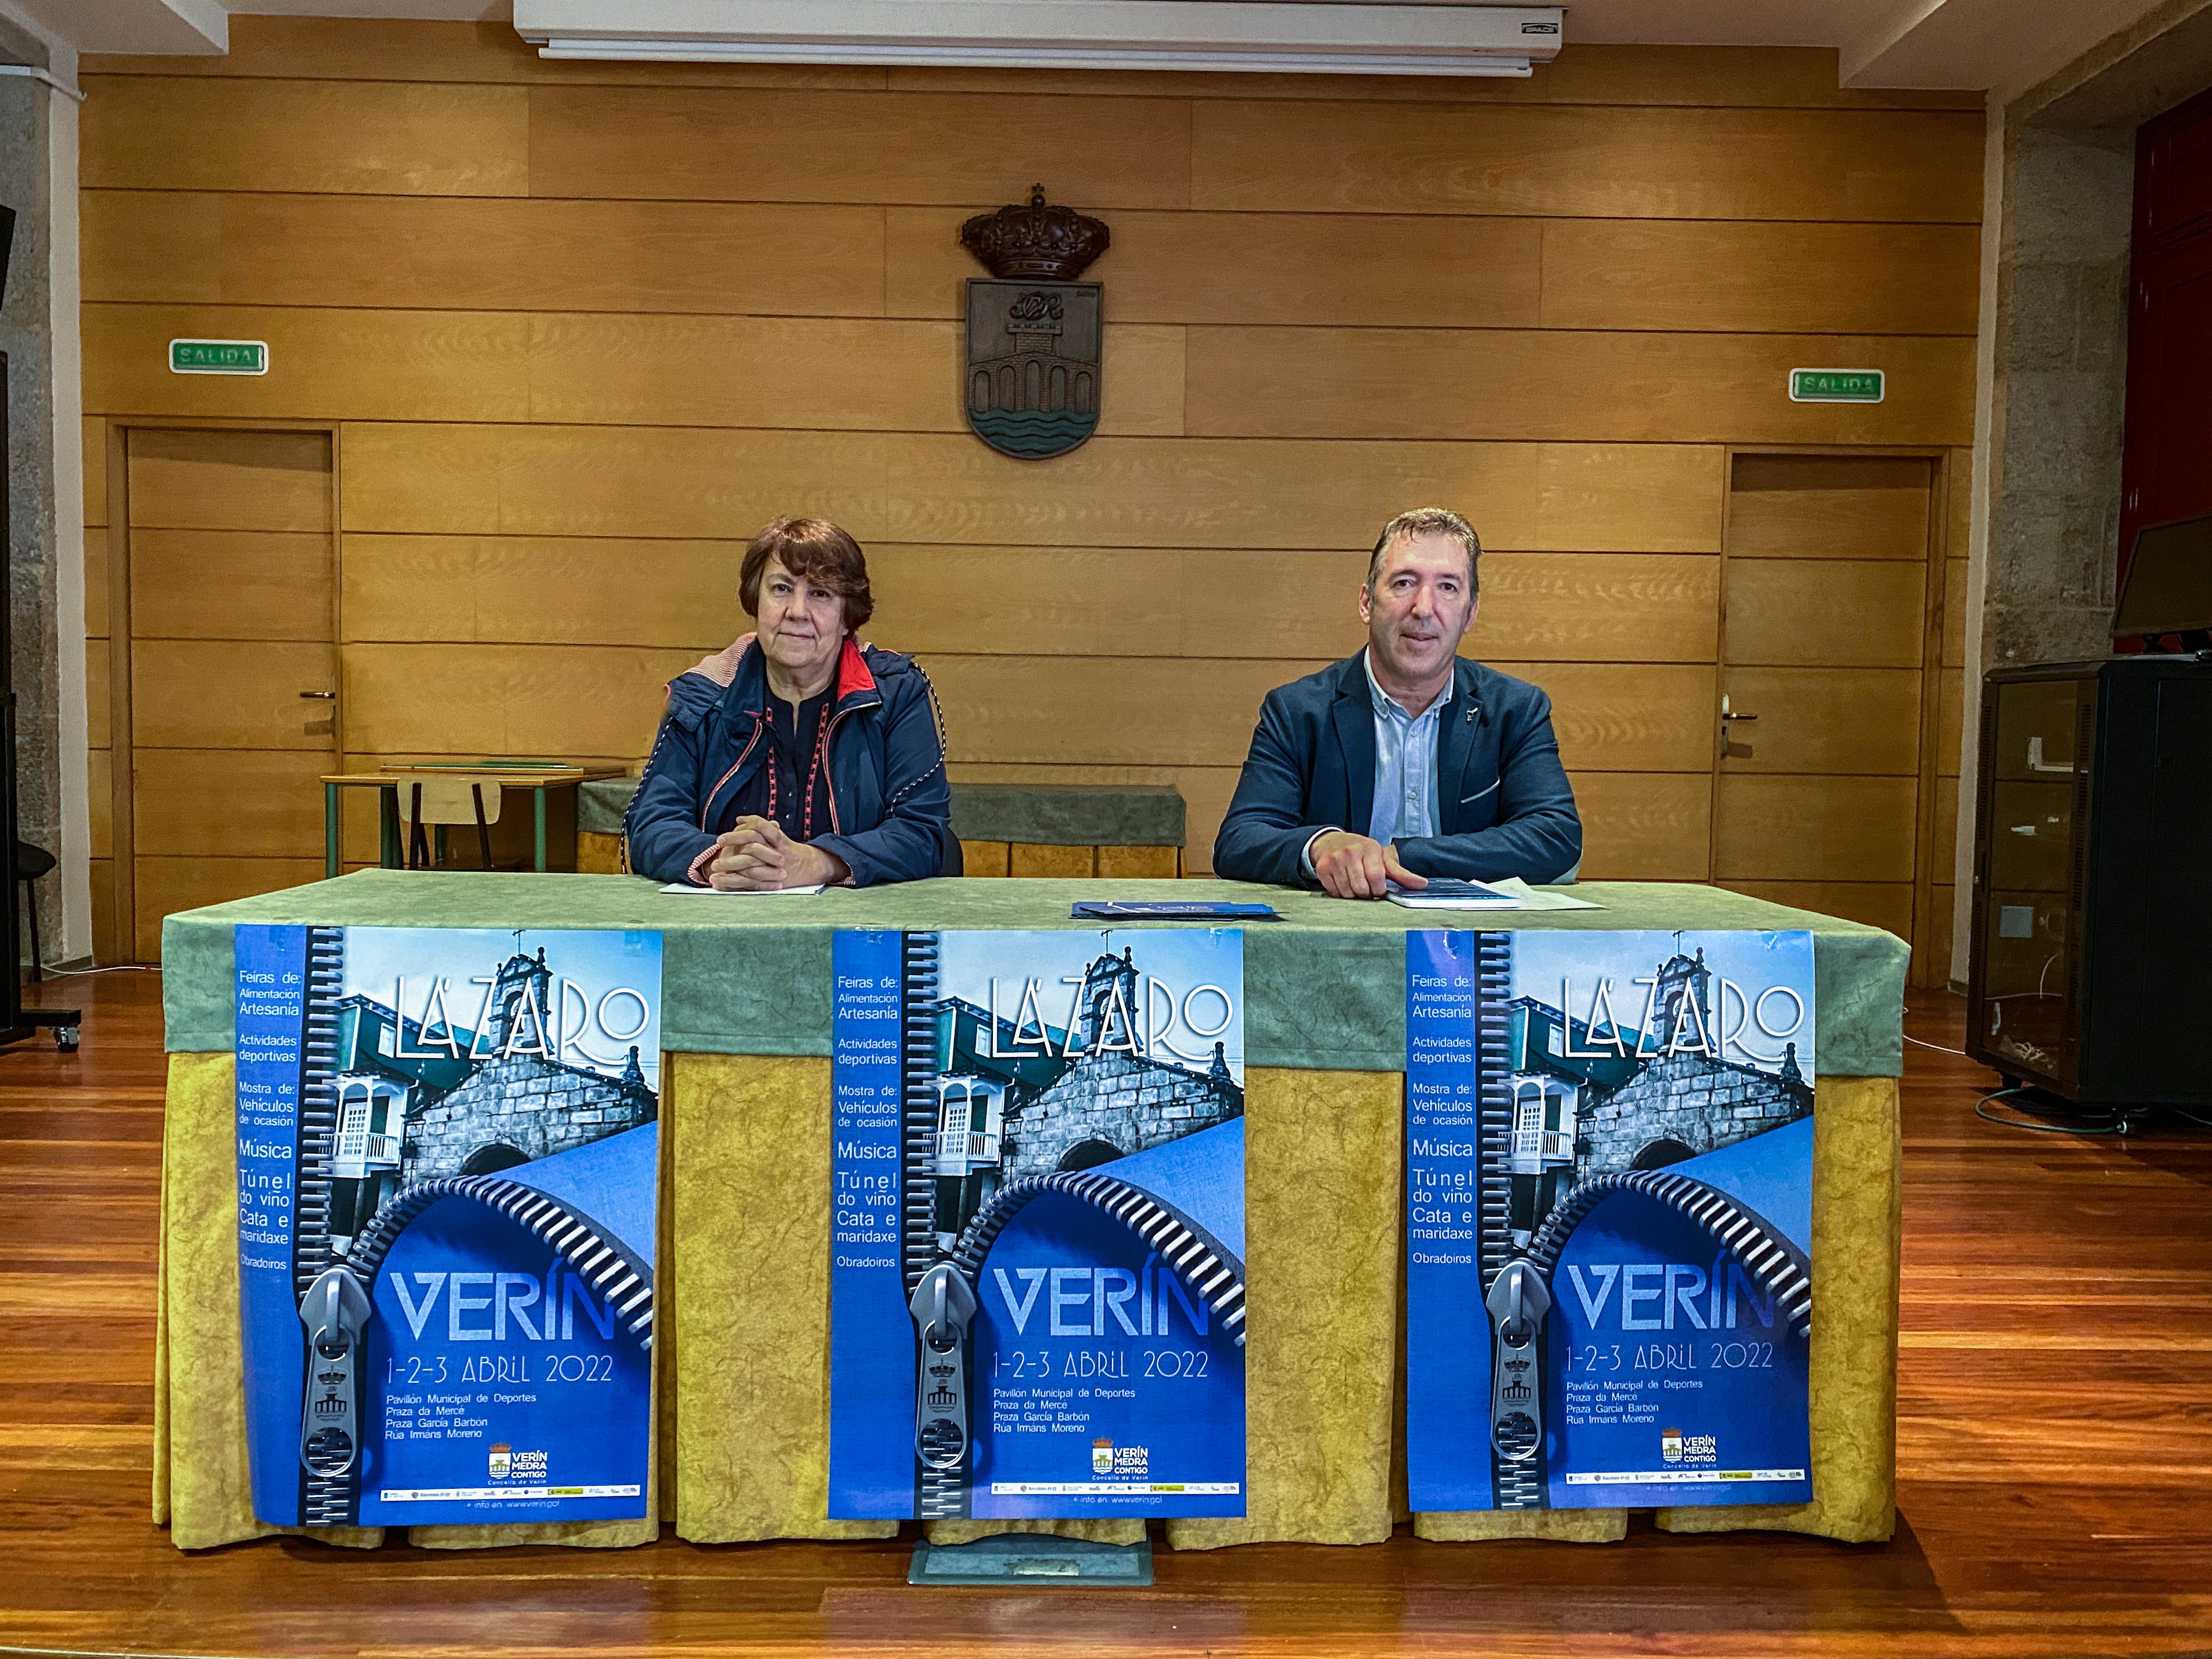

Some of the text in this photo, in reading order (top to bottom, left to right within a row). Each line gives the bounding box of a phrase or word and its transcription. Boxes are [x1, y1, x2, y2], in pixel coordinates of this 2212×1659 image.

[180, 348, 251, 363] SALIDA
[1805, 377, 1874, 391] SALIDA
[240, 970, 301, 984] Feiras de:
[839, 977, 897, 988] Feiras de:
[1413, 975, 1471, 987] Feiras de:
[240, 988, 300, 999] Alimentación
[838, 992, 897, 1003] Alimentación
[1413, 991, 1471, 1002] Alimentación
[240, 1002, 299, 1015] Artesanía
[839, 1006, 897, 1019] Artesanía
[1413, 1004, 1471, 1018] Artesanía
[396, 976, 649, 1065] LÁZARO
[991, 976, 1233, 1061] LÁZARO
[1564, 977, 1804, 1062] LÁZARO
[240, 1034, 296, 1046] Actividades
[839, 1038, 897, 1048] Actividades
[1413, 1037, 1471, 1047] Actividades
[239, 1049, 296, 1064] deportivas
[839, 1053, 897, 1067] deportivas
[1413, 1052, 1471, 1065] deportivas
[240, 1081, 295, 1094] Mostra de:
[839, 1085, 897, 1096] Mostra de:
[1413, 1083, 1472, 1094] Mostra de:
[240, 1098, 294, 1112] Vehículos
[839, 1100, 897, 1113] Vehículos
[1413, 1098, 1472, 1111] Vehículos
[239, 1114, 293, 1126] de ocasión
[838, 1116, 897, 1127] de ocasión
[1413, 1114, 1472, 1125] de ocasión
[240, 1139, 291, 1158] Música
[839, 1140, 896, 1159] Música
[1414, 1138, 1472, 1156] Música
[240, 1169, 290, 1189] Túnel
[837, 1170, 896, 1189] Túnel
[1413, 1168, 1472, 1186] Túnel
[240, 1190, 289, 1207] do viño
[838, 1190, 896, 1206] do viño
[1413, 1188, 1472, 1203] do viño
[240, 1208, 288, 1227] Cata e
[837, 1211, 895, 1226] Cata e
[1413, 1207, 1472, 1223] Cata e
[240, 1230, 288, 1244] maridaxe
[837, 1230, 896, 1242] maridaxe
[1413, 1227, 1472, 1239] maridaxe
[240, 1254, 286, 1270] Obradoiros
[837, 1256, 895, 1267] Obradoiros
[1413, 1253, 1471, 1263] Obradoiros
[993, 1252, 1208, 1336] VERÍN
[1567, 1249, 1776, 1331] VERÍN
[390, 1256, 615, 1341] VERÍN
[1567, 1345, 1620, 1371] 1-2-3
[1711, 1342, 1772, 1368] 2022
[387, 1357, 447, 1383] 1-2-3
[546, 1355, 612, 1381] 2022
[993, 1351, 1049, 1377] 1-2-3
[1144, 1351, 1207, 1377] 2022
[1604, 1381, 1643, 1391] Municipal
[1648, 1380, 1658, 1388] de
[1664, 1380, 1702, 1390] Deportes
[428, 1394, 470, 1405] Municipal
[477, 1394, 488, 1403] de
[494, 1394, 536, 1404] Deportes
[1032, 1388, 1073, 1400] Municipal
[1078, 1388, 1089, 1397] de
[1095, 1388, 1135, 1399] Deportes
[1567, 1394, 1590, 1402] Praza
[1596, 1393, 1606, 1401] da
[386, 1407, 412, 1416] Praza
[419, 1406, 431, 1415] da
[994, 1400, 1018, 1409] Praza
[1567, 1405, 1590, 1413] Praza
[994, 1412, 1018, 1421] Praza
[1623, 1414, 1654, 1423] Moreno
[386, 1419, 412, 1428] Praza
[1052, 1423, 1084, 1432] Moreno
[447, 1429, 482, 1438] Moreno
[1683, 1435, 1715, 1446] VERÍN
[512, 1450, 547, 1461] VERÍN
[1115, 1446, 1148, 1458] VERÍN
